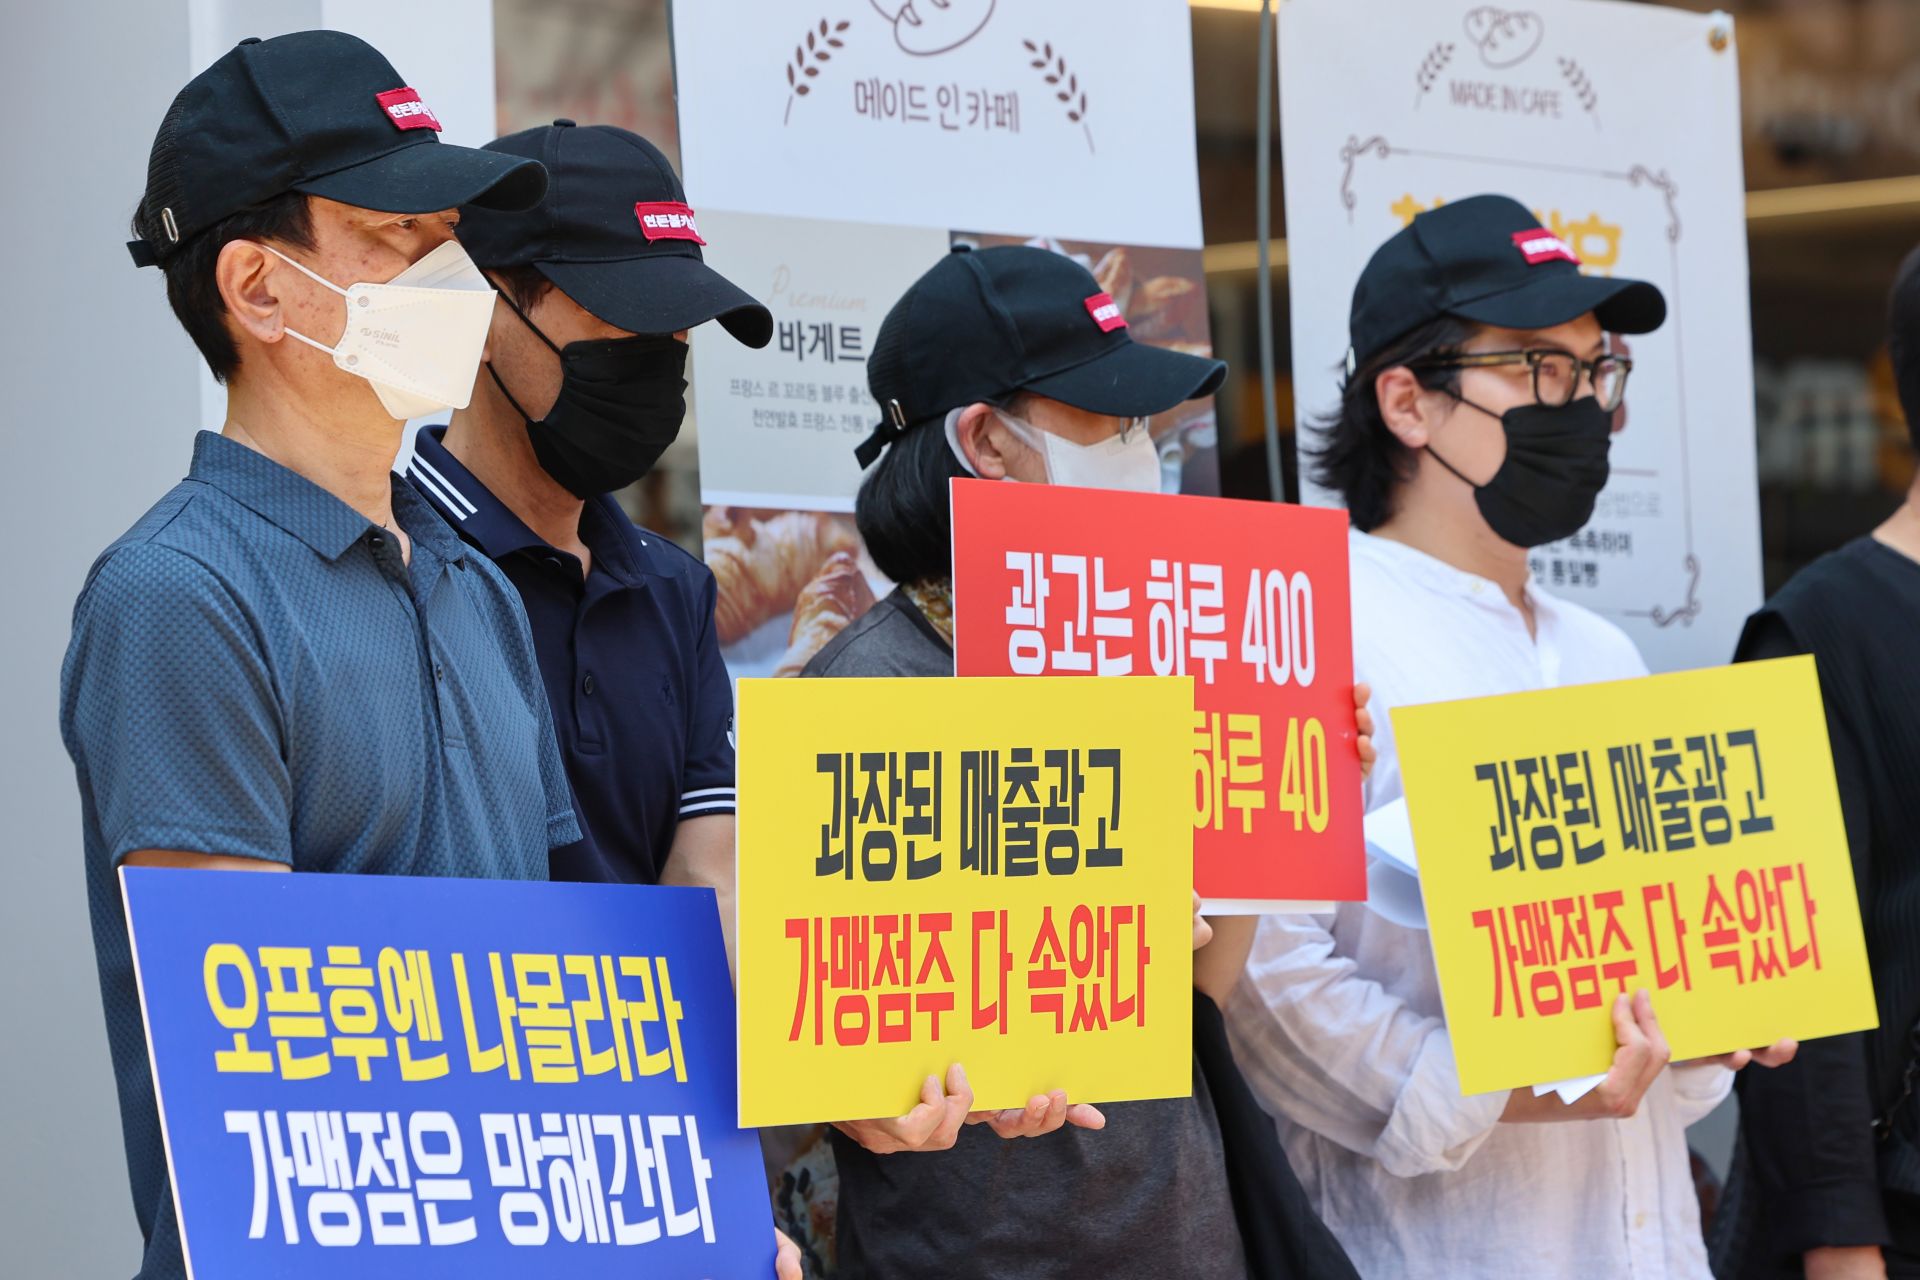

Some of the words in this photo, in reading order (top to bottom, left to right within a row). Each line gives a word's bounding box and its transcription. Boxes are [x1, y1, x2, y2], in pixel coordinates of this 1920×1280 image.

[854, 77, 930, 123] 메이드
[936, 82, 960, 131] 인
[966, 88, 1020, 133] 카페
[1449, 79, 1496, 111] MADE
[1502, 84, 1518, 114] IN
[1521, 87, 1562, 119] CAFE
[766, 264, 870, 312] Premium
[778, 319, 866, 363] 바게트
[729, 378, 764, 398] 프랑스
[822, 383, 845, 403] 블루
[802, 411, 837, 432] 프랑스
[1005, 551, 1133, 676] 광고는
[1146, 558, 1228, 684] 하루
[1241, 568, 1315, 687] 400
[815, 750, 942, 882] 과장된
[960, 747, 1123, 877] 매출광고
[1194, 710, 1265, 833] 하루
[1279, 716, 1329, 833] 40
[1474, 750, 1606, 872] 과장된
[1606, 729, 1775, 855] 매출광고
[785, 912, 955, 1046] 가맹점주
[971, 909, 1013, 1035] 다
[1027, 904, 1150, 1035] 속았다
[1472, 889, 1639, 1019] 가맹점주
[1641, 881, 1692, 992] 다
[1702, 862, 1822, 986] 속았다
[203, 943, 450, 1082] 오픈후엔
[451, 951, 688, 1083] 나몰라라
[223, 1110, 477, 1247] 가맹점은
[479, 1112, 716, 1247] 망해간다
